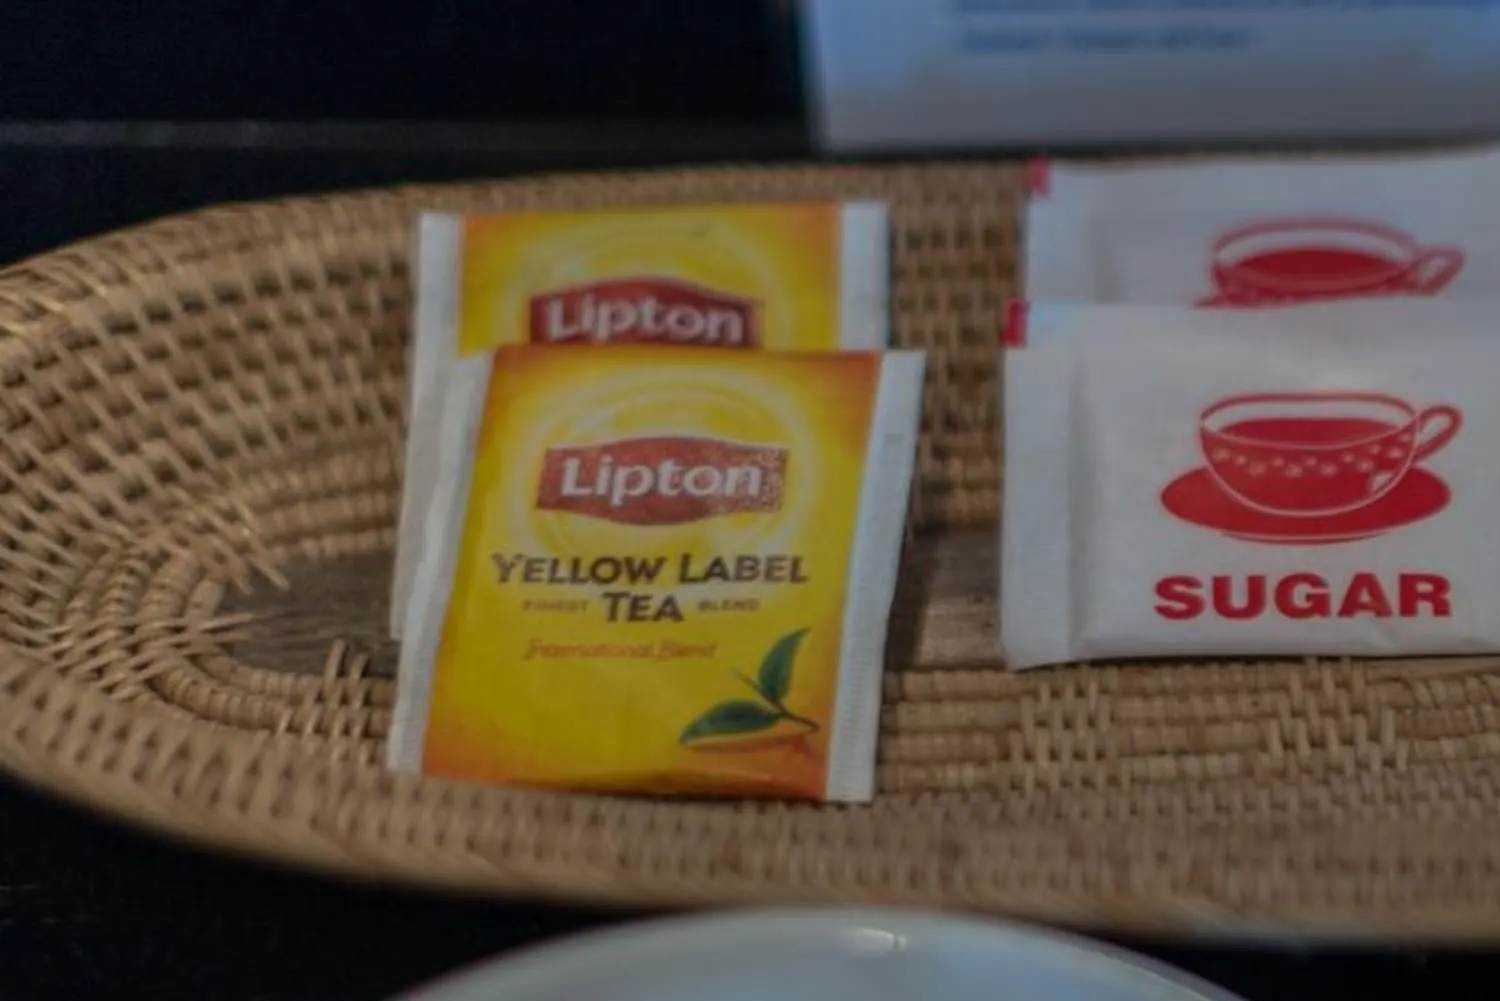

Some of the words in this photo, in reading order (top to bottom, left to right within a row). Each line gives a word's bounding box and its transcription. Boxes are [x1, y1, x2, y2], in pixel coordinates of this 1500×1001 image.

[545, 297, 744, 344] Lipton
[561, 456, 763, 505] Lipton
[492, 553, 667, 585] YELLOW
[679, 552, 810, 584] LABEL
[602, 591, 685, 623] TEA
[697, 598, 761, 613] BLEND
[1153, 572, 1452, 620] SUGAR
